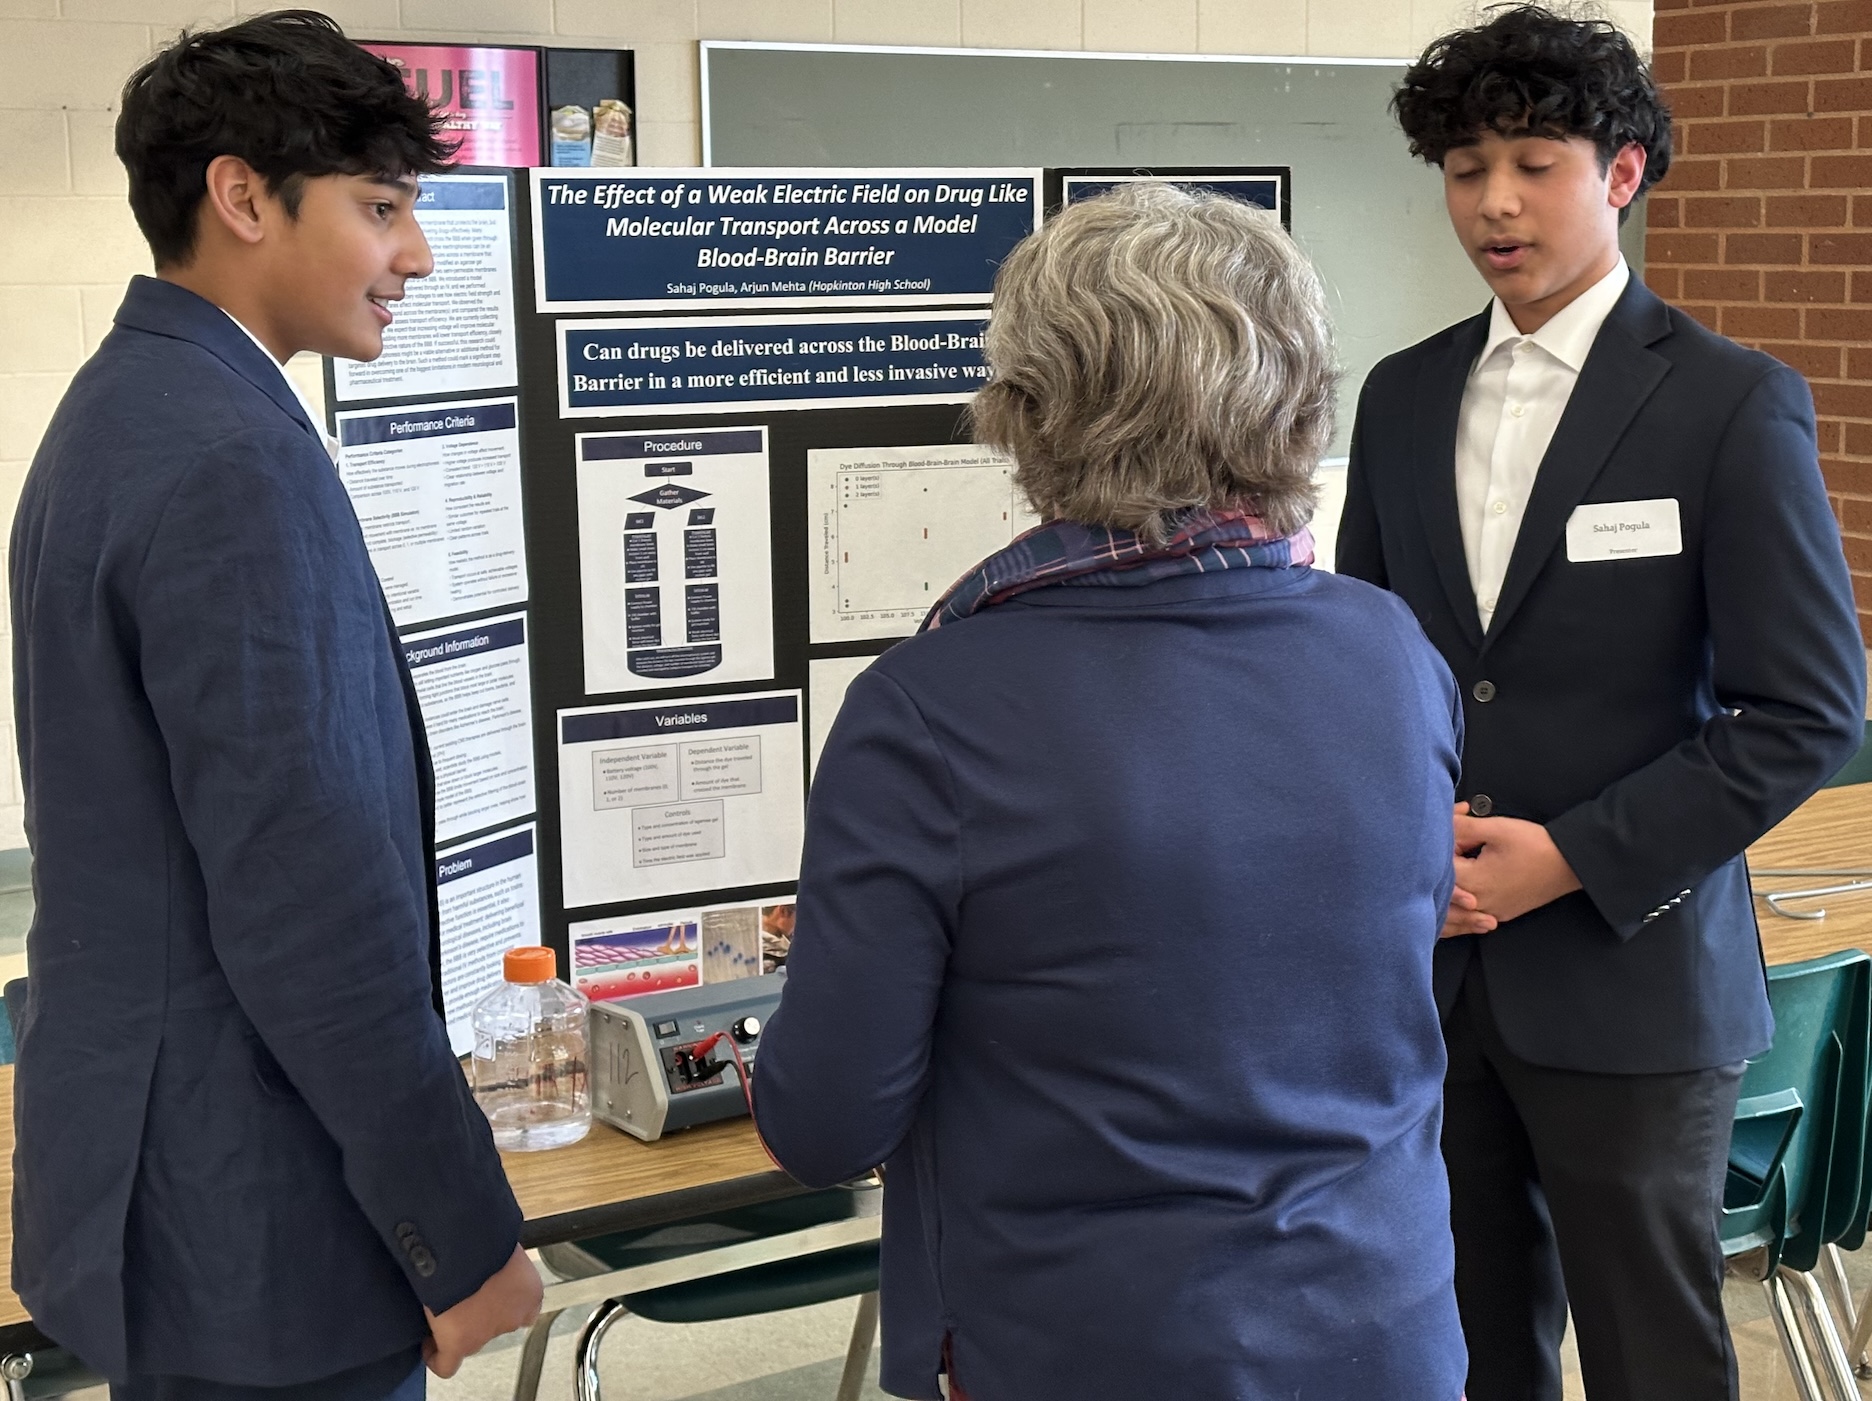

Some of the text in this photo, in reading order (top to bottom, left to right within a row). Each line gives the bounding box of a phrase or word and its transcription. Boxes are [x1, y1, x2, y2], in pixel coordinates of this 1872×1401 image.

[401, 69, 514, 110] UEL
[548, 183, 1029, 209] The Effect of a Weak Electric Field on Drug Like
[606, 214, 979, 239] Molecular Transport Across a Model
[697, 246, 895, 268] Blood-Brain Barrier
[667, 278, 931, 296] Sahaj Pogula, Arjun Mehta (Hopkinton High School)
[583, 332, 986, 363] Can drugs be delivered across the Blood-Brai
[573, 373, 643, 391] Barrier
[648, 372, 667, 389] in
[672, 376, 684, 389] a
[687, 374, 734, 388] more
[740, 368, 812, 386] efficient
[815, 366, 848, 384] and
[853, 366, 884, 382] less
[888, 363, 957, 381] invasive
[390, 415, 475, 435] Performance Criteria
[644, 440, 703, 452] Procedure
[882, 461, 907, 469] Through
[961, 457, 980, 465] Model
[1593, 520, 1650, 534] Sahaj Pogula
[405, 635, 489, 663] ckground Information
[655, 713, 708, 727] Variables
[599, 752, 667, 764] Independent Variable
[688, 744, 749, 756] Dependent Variable
[664, 809, 691, 818] Controls
[438, 859, 472, 878] Problem
